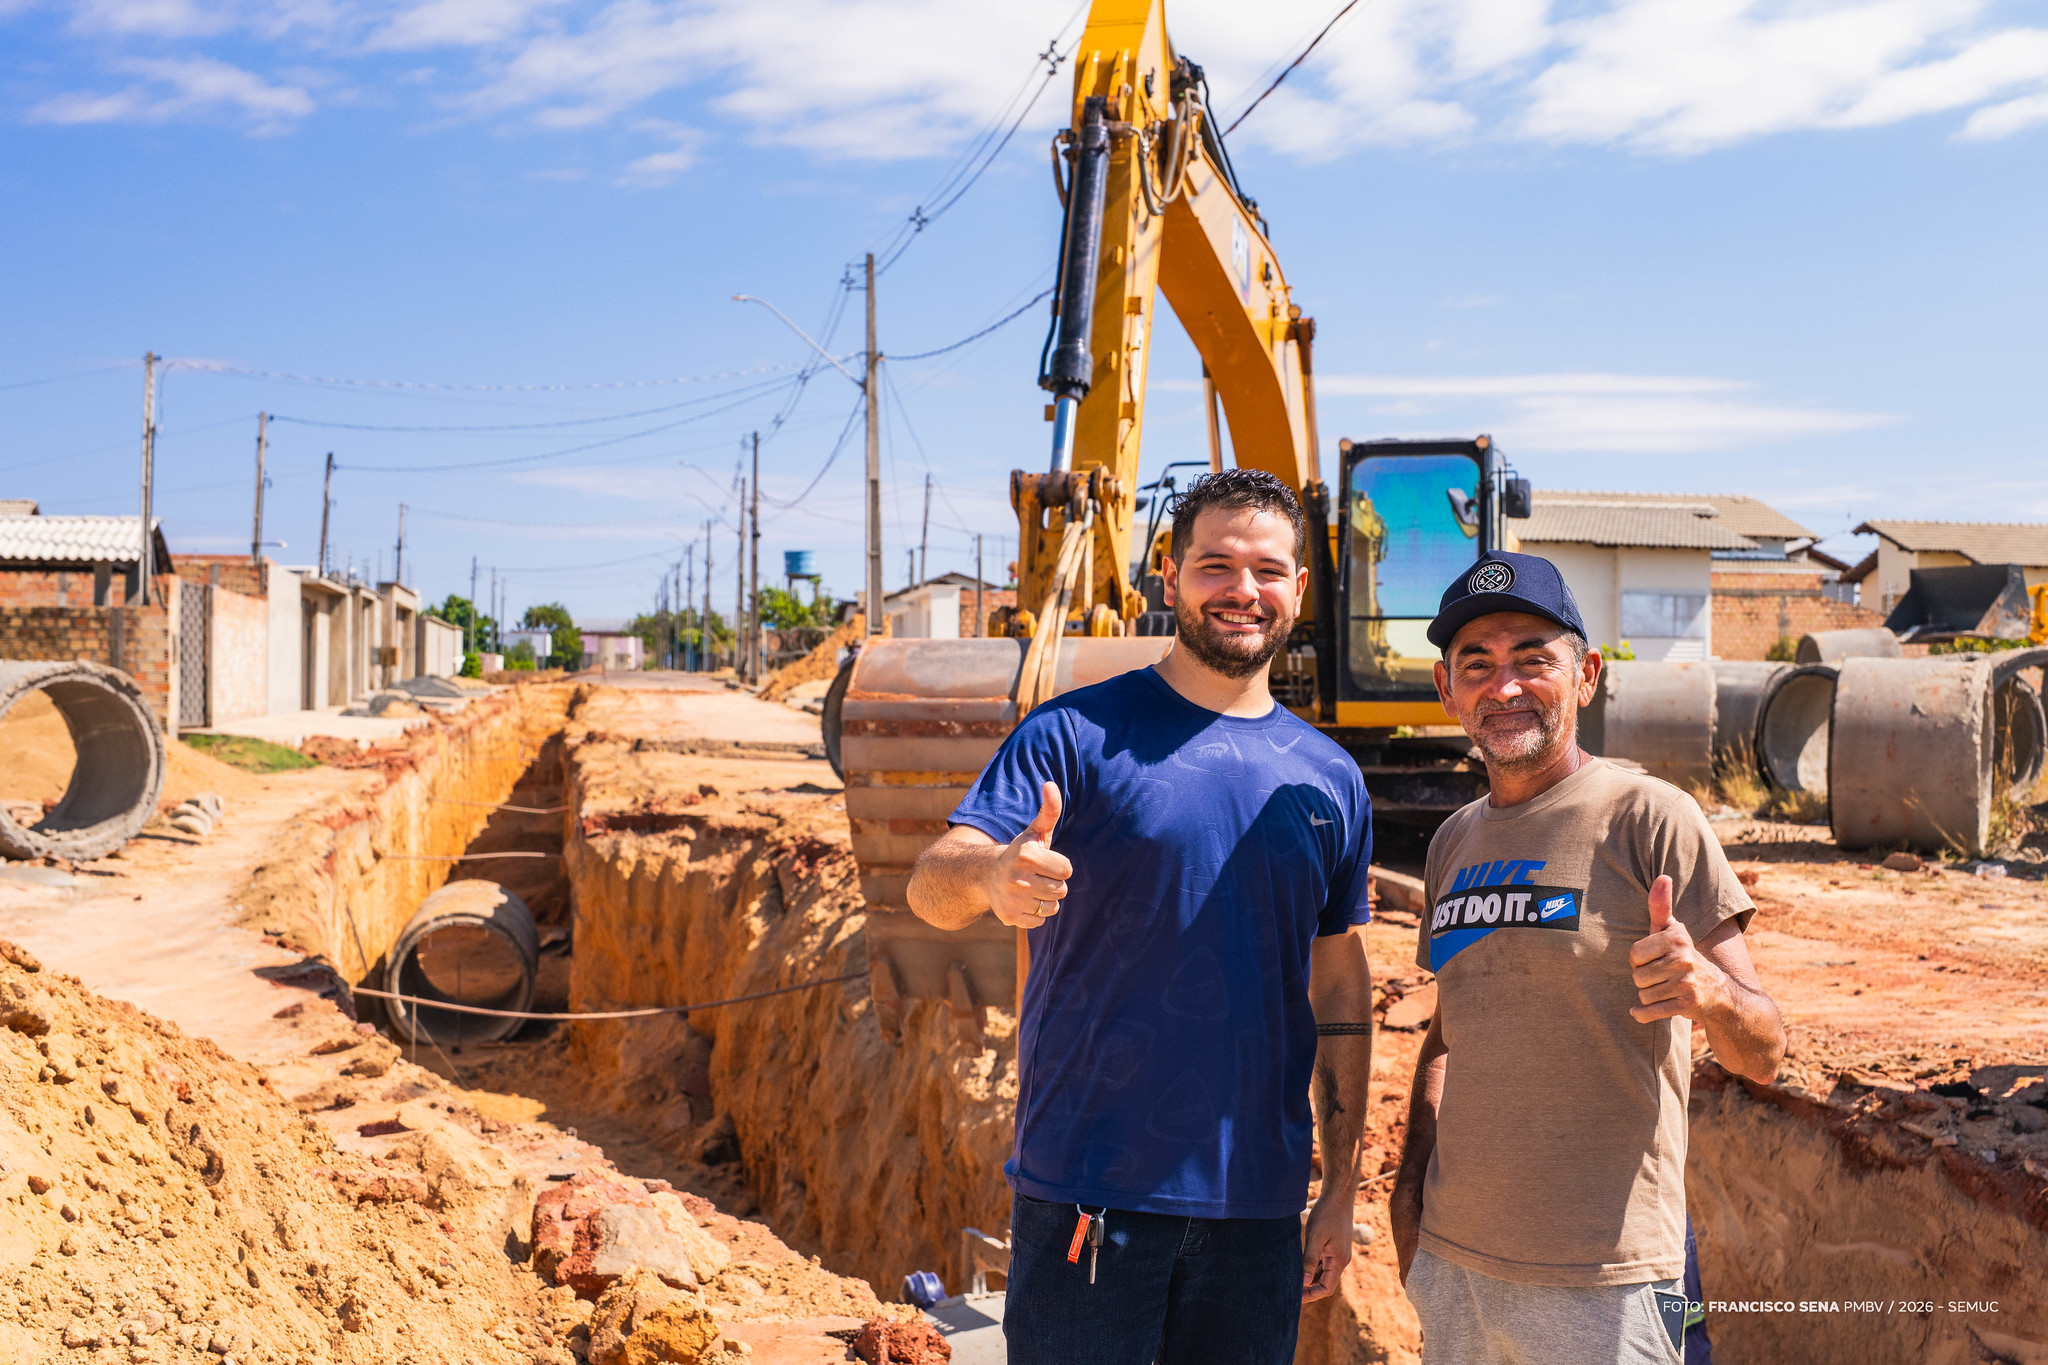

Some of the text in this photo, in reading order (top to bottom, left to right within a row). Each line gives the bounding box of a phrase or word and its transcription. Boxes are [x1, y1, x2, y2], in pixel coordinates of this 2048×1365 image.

[1449, 860, 1547, 894] NIKE
[1431, 893, 1538, 931] UST DO IT.
[1545, 897, 1566, 911] NIKE
